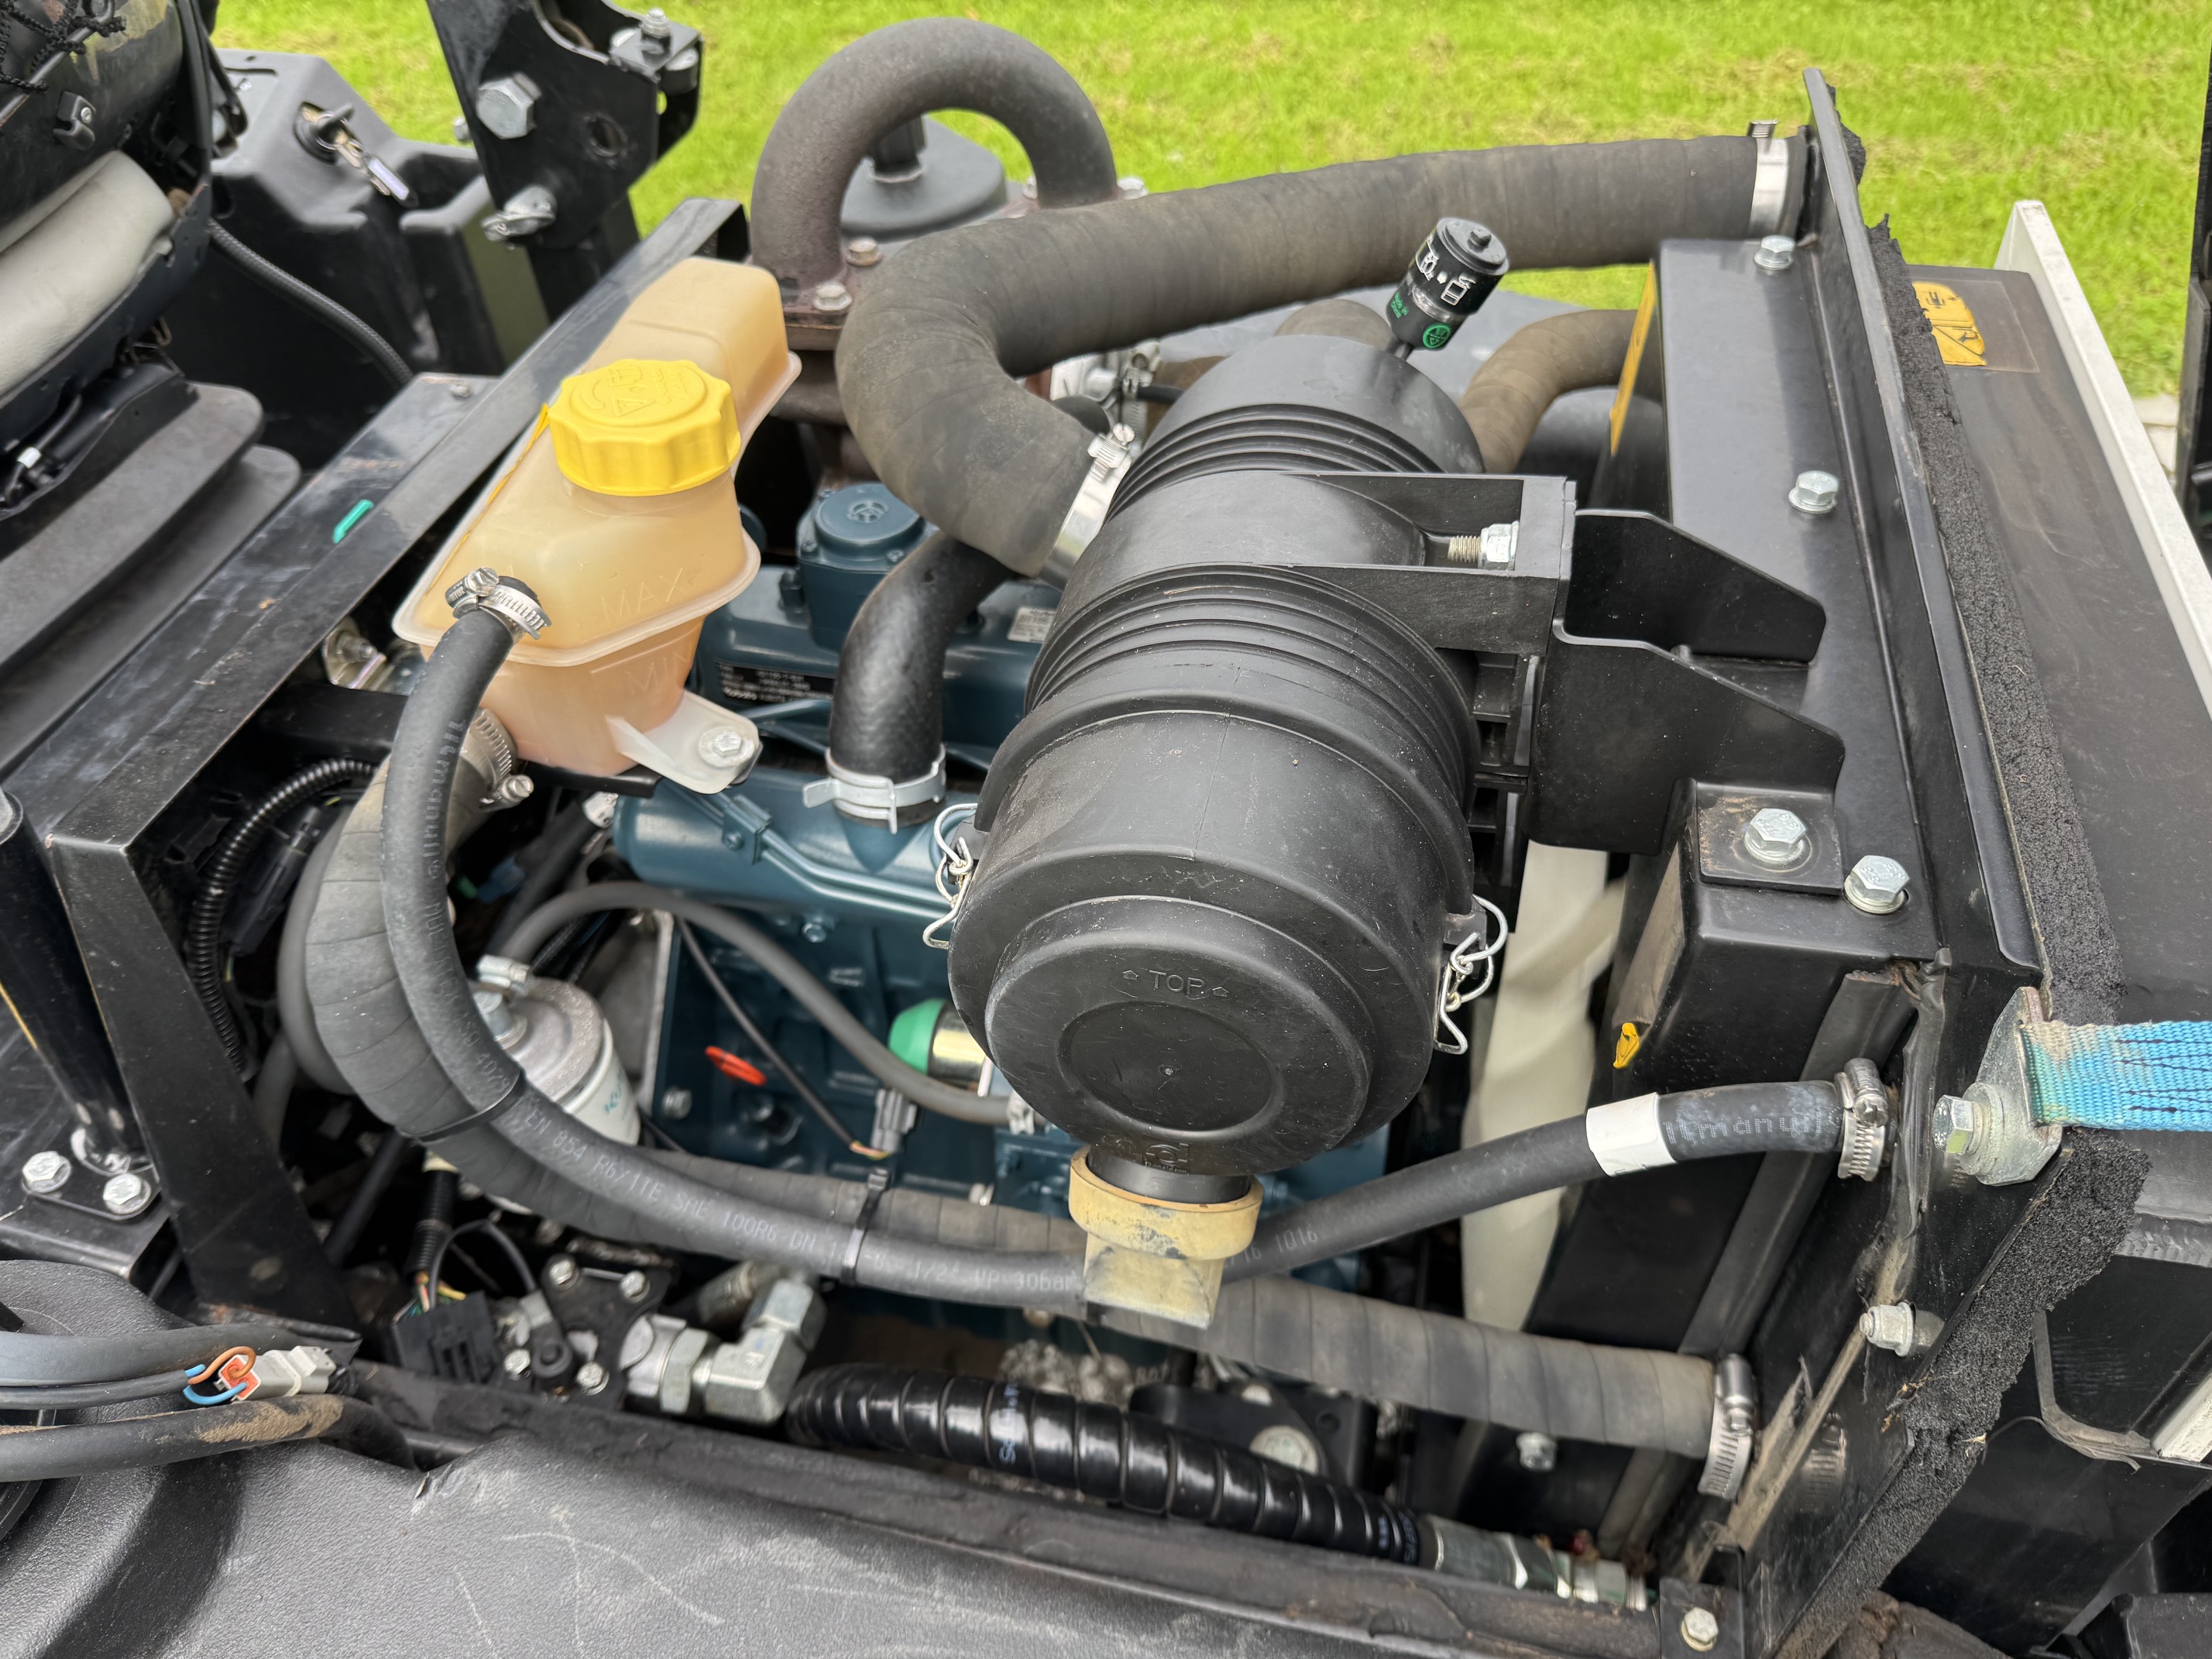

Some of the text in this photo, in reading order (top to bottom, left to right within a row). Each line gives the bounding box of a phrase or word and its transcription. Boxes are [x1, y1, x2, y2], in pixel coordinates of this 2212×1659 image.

[602, 568, 689, 625] MAX
[1149, 969, 1206, 995] TOP
[524, 1108, 552, 1135] EN
[722, 1210, 779, 1242] 100R6
